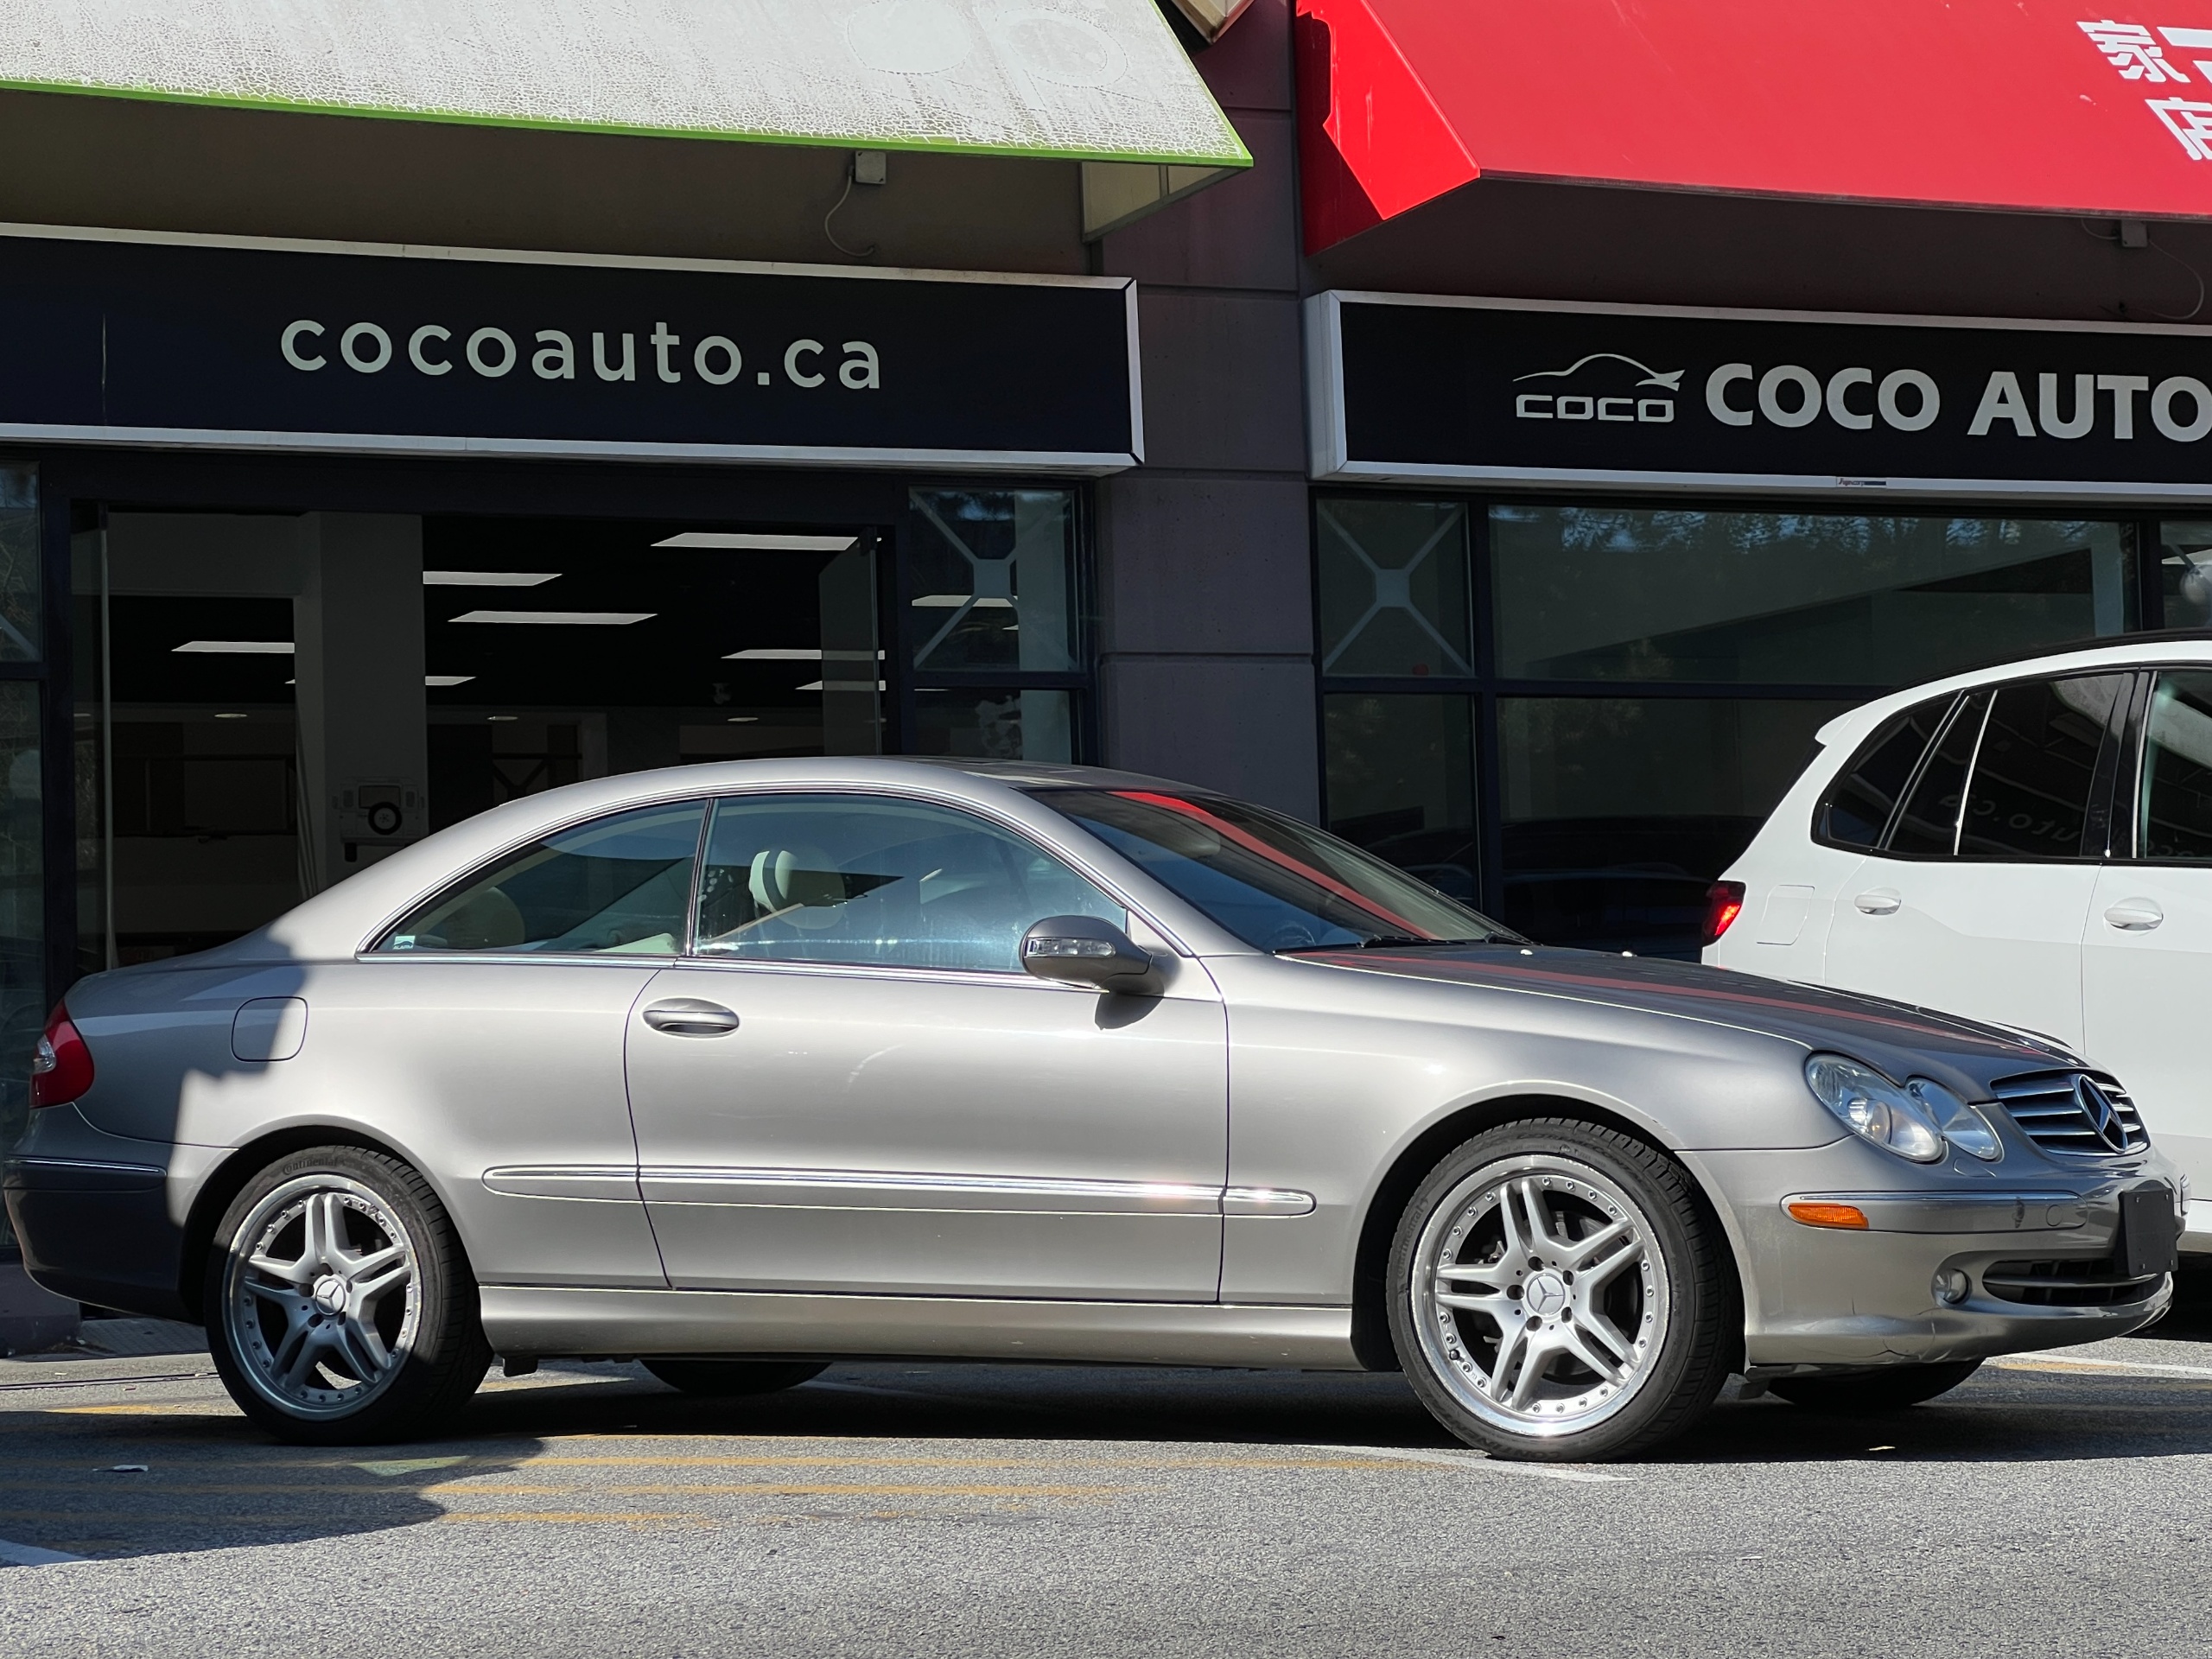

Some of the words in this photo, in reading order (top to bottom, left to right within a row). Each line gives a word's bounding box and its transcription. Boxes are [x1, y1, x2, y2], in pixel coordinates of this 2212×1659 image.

[281, 320, 880, 390] cocoauto.ca
[1515, 394, 1675, 423] COCO
[1706, 363, 1941, 432] COCO
[1967, 371, 2212, 442] AUTO
